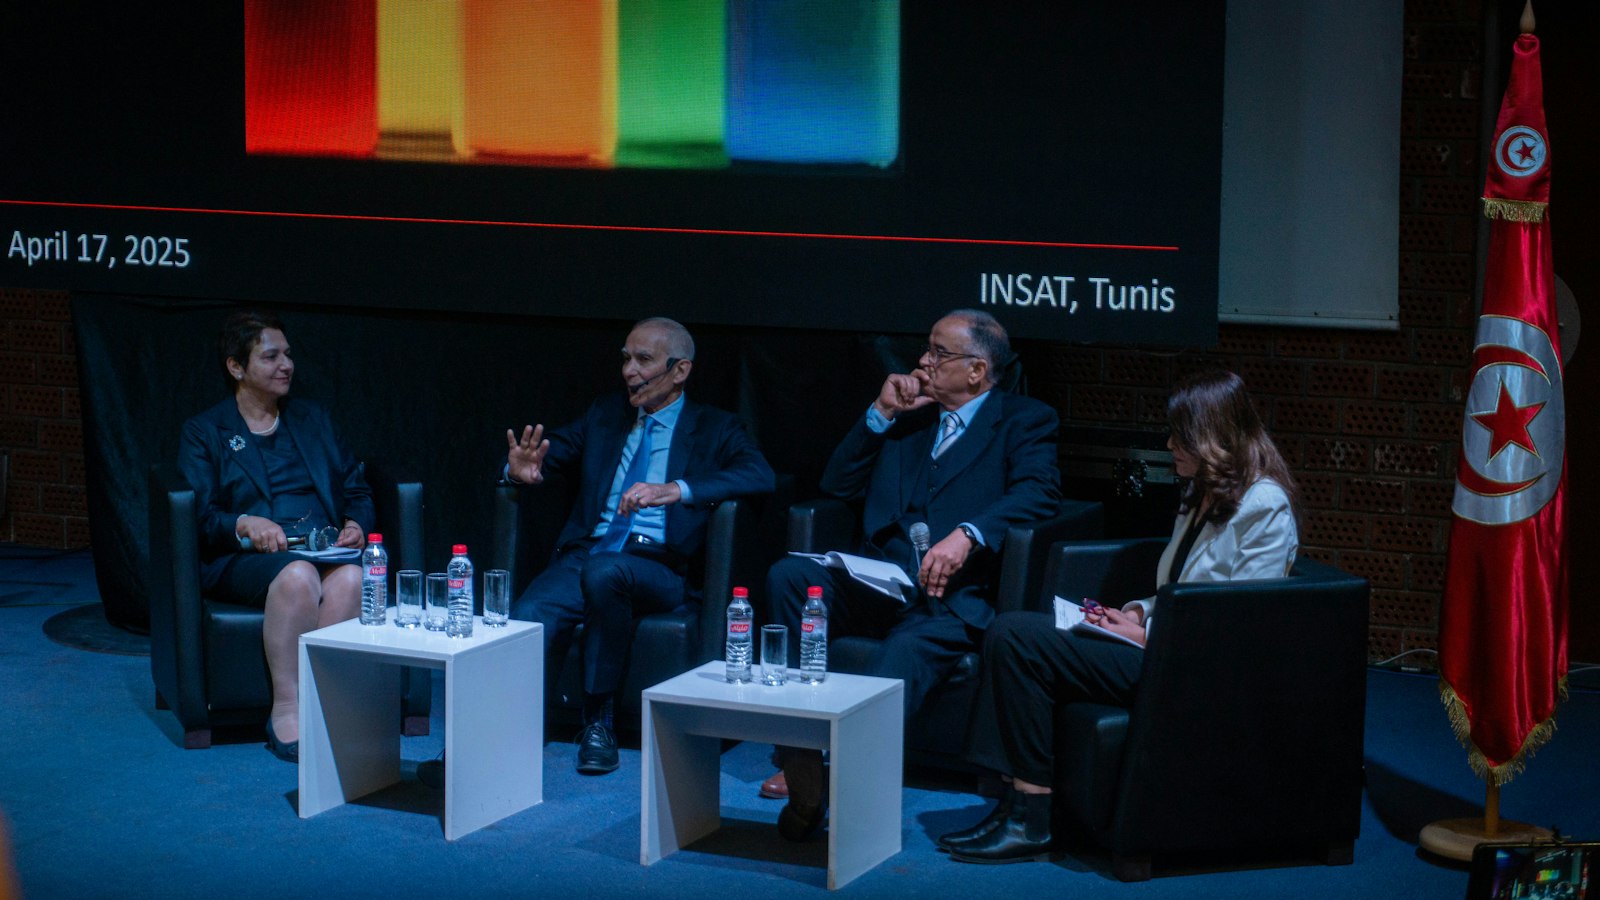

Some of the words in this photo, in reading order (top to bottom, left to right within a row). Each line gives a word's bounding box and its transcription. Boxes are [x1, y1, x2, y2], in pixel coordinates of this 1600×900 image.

[8, 230, 68, 266] April
[77, 233, 116, 269] 17,
[125, 235, 191, 267] 2025
[980, 272, 1078, 314] INSAT,
[1088, 277, 1175, 313] Tunis
